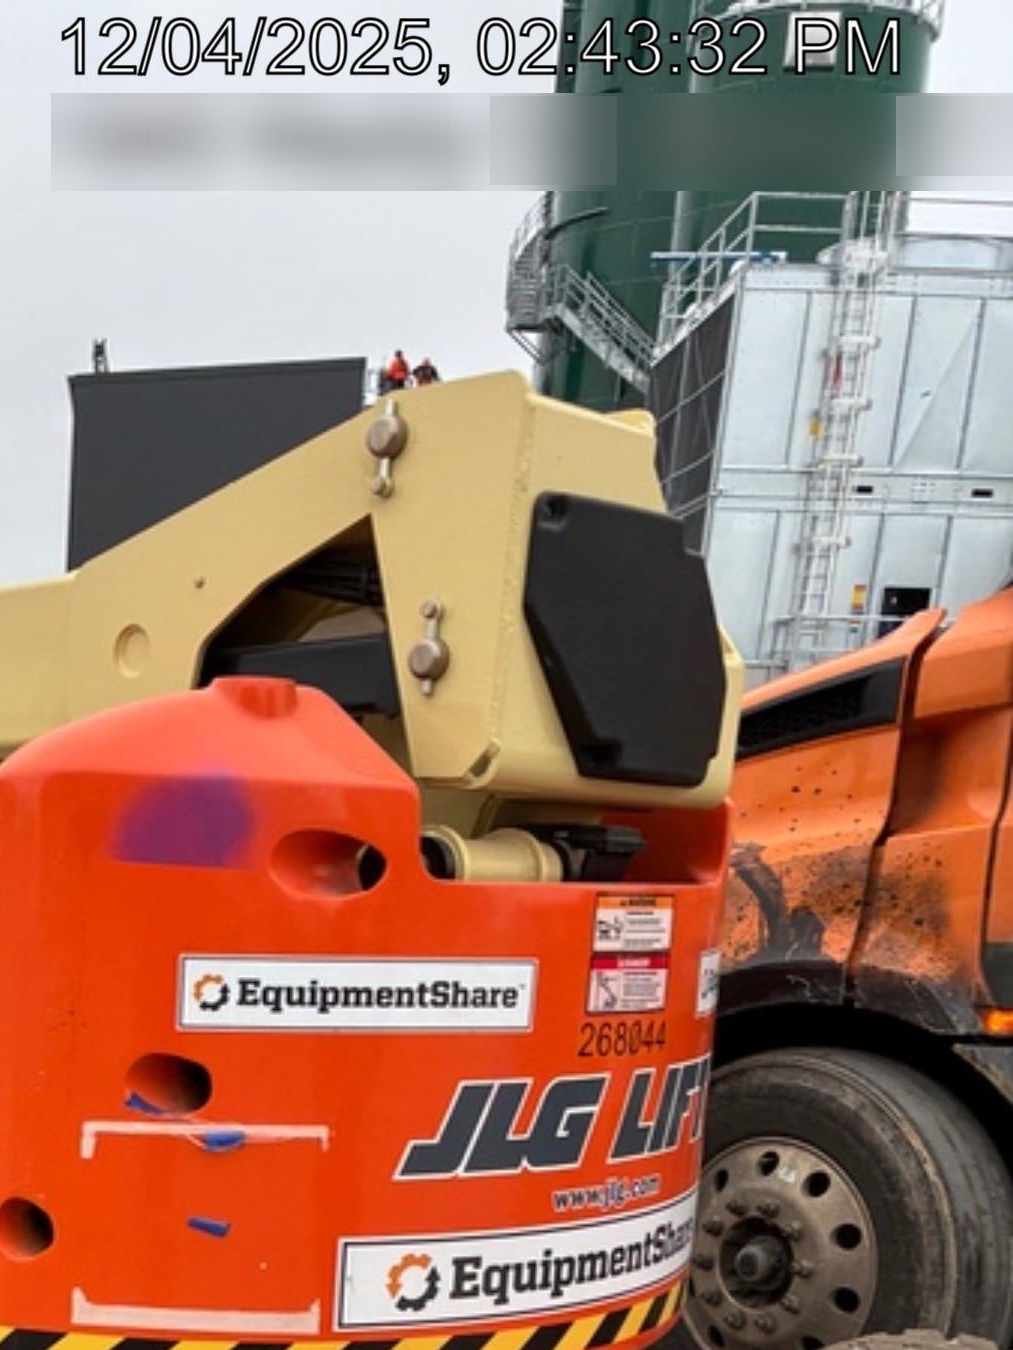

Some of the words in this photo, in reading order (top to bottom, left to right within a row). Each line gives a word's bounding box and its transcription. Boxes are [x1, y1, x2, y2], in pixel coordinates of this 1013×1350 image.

[237, 979, 520, 1014] EquipmentShare
[578, 1019, 667, 1058] 268044
[393, 1072, 611, 1180] JLG
[552, 1173, 661, 1212] www.jlg.com
[448, 1217, 695, 1305] EquipmentShar
